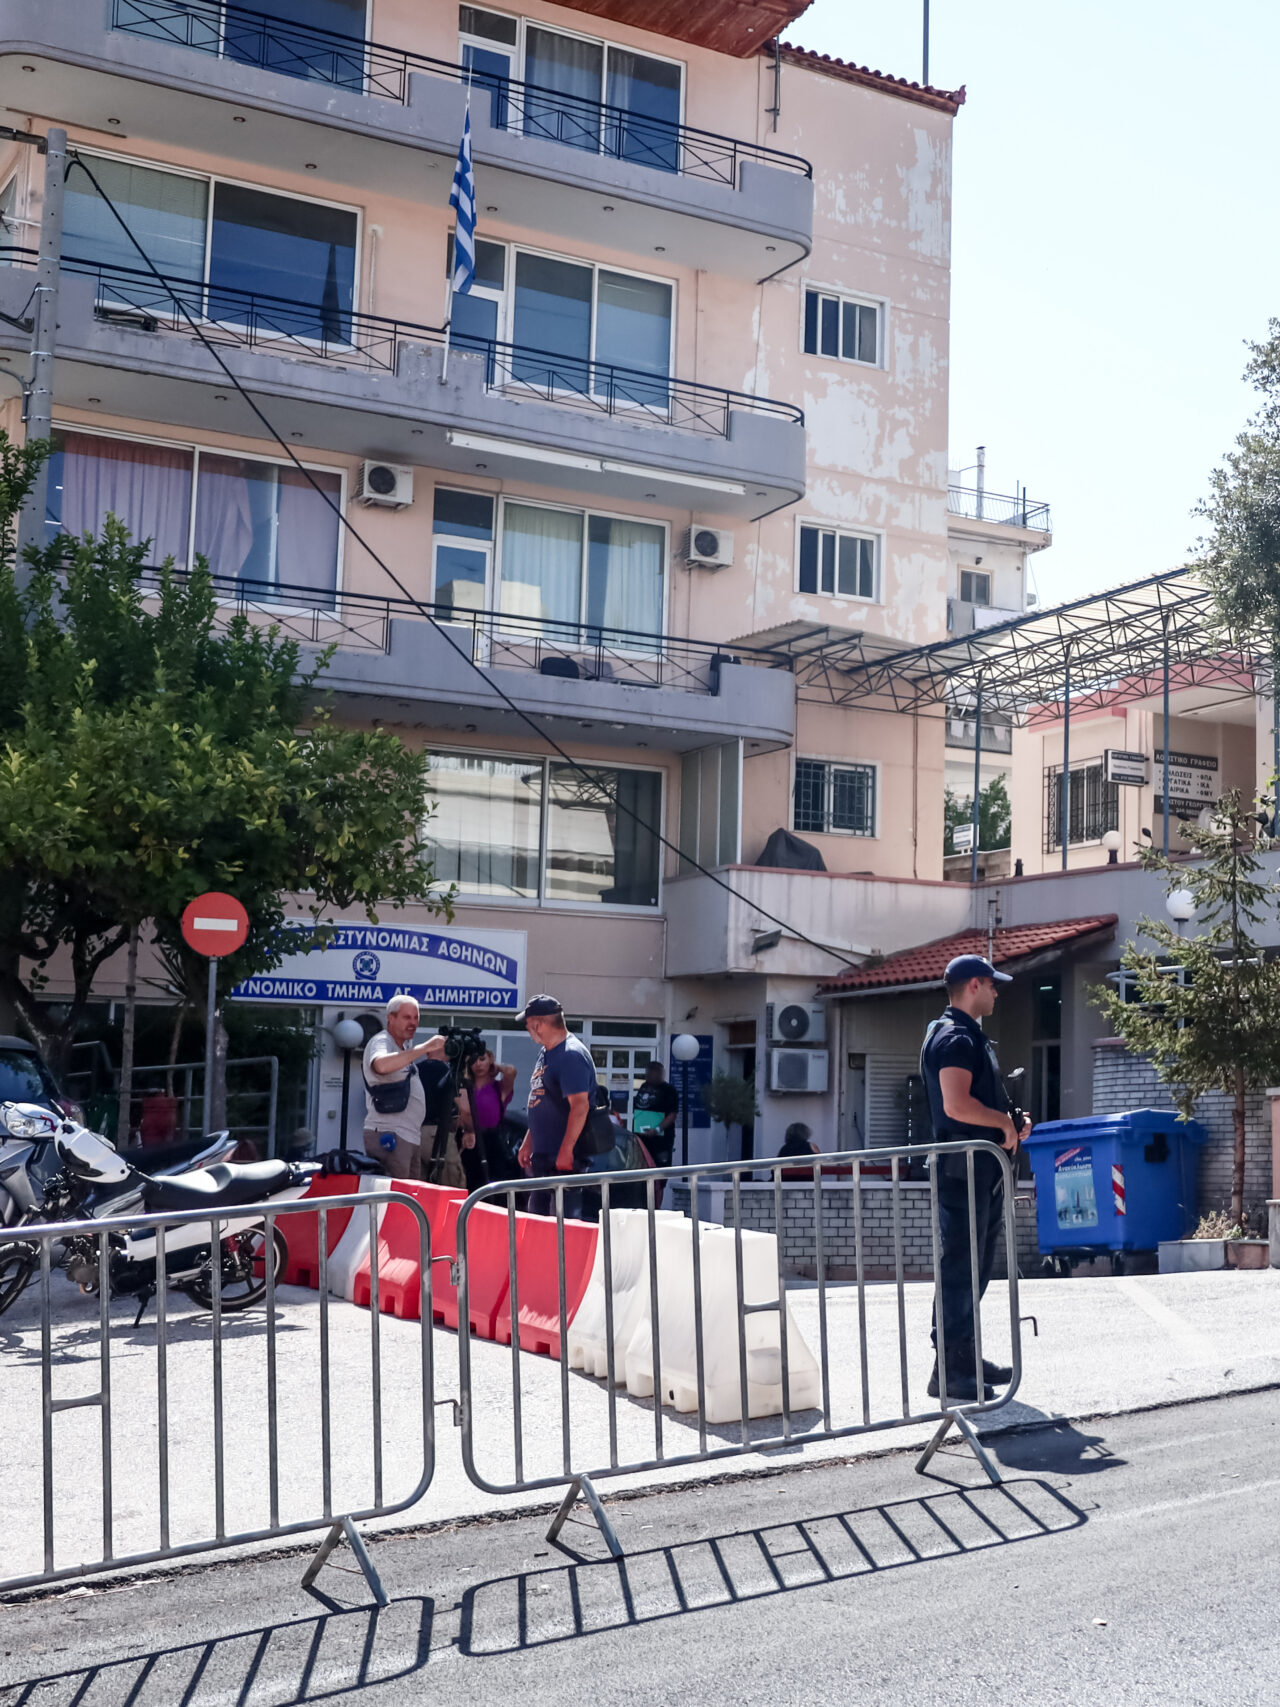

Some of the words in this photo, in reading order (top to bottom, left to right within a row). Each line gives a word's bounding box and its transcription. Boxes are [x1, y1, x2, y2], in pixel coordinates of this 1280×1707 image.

[1155, 753, 1188, 765] ΛΟΙΣΤΙΚΟ
[1190, 759, 1217, 769] ΓΡΑΦΕΙΟ
[1163, 785, 1190, 794] ΑΙΡΙΚΑ
[437, 940, 508, 976] ΑΘΗΝΩΝ
[326, 983, 383, 1001] ΤΜΗΜΑ
[424, 987, 512, 1006] ΔΗΜΗΤΡΙΟΥ
